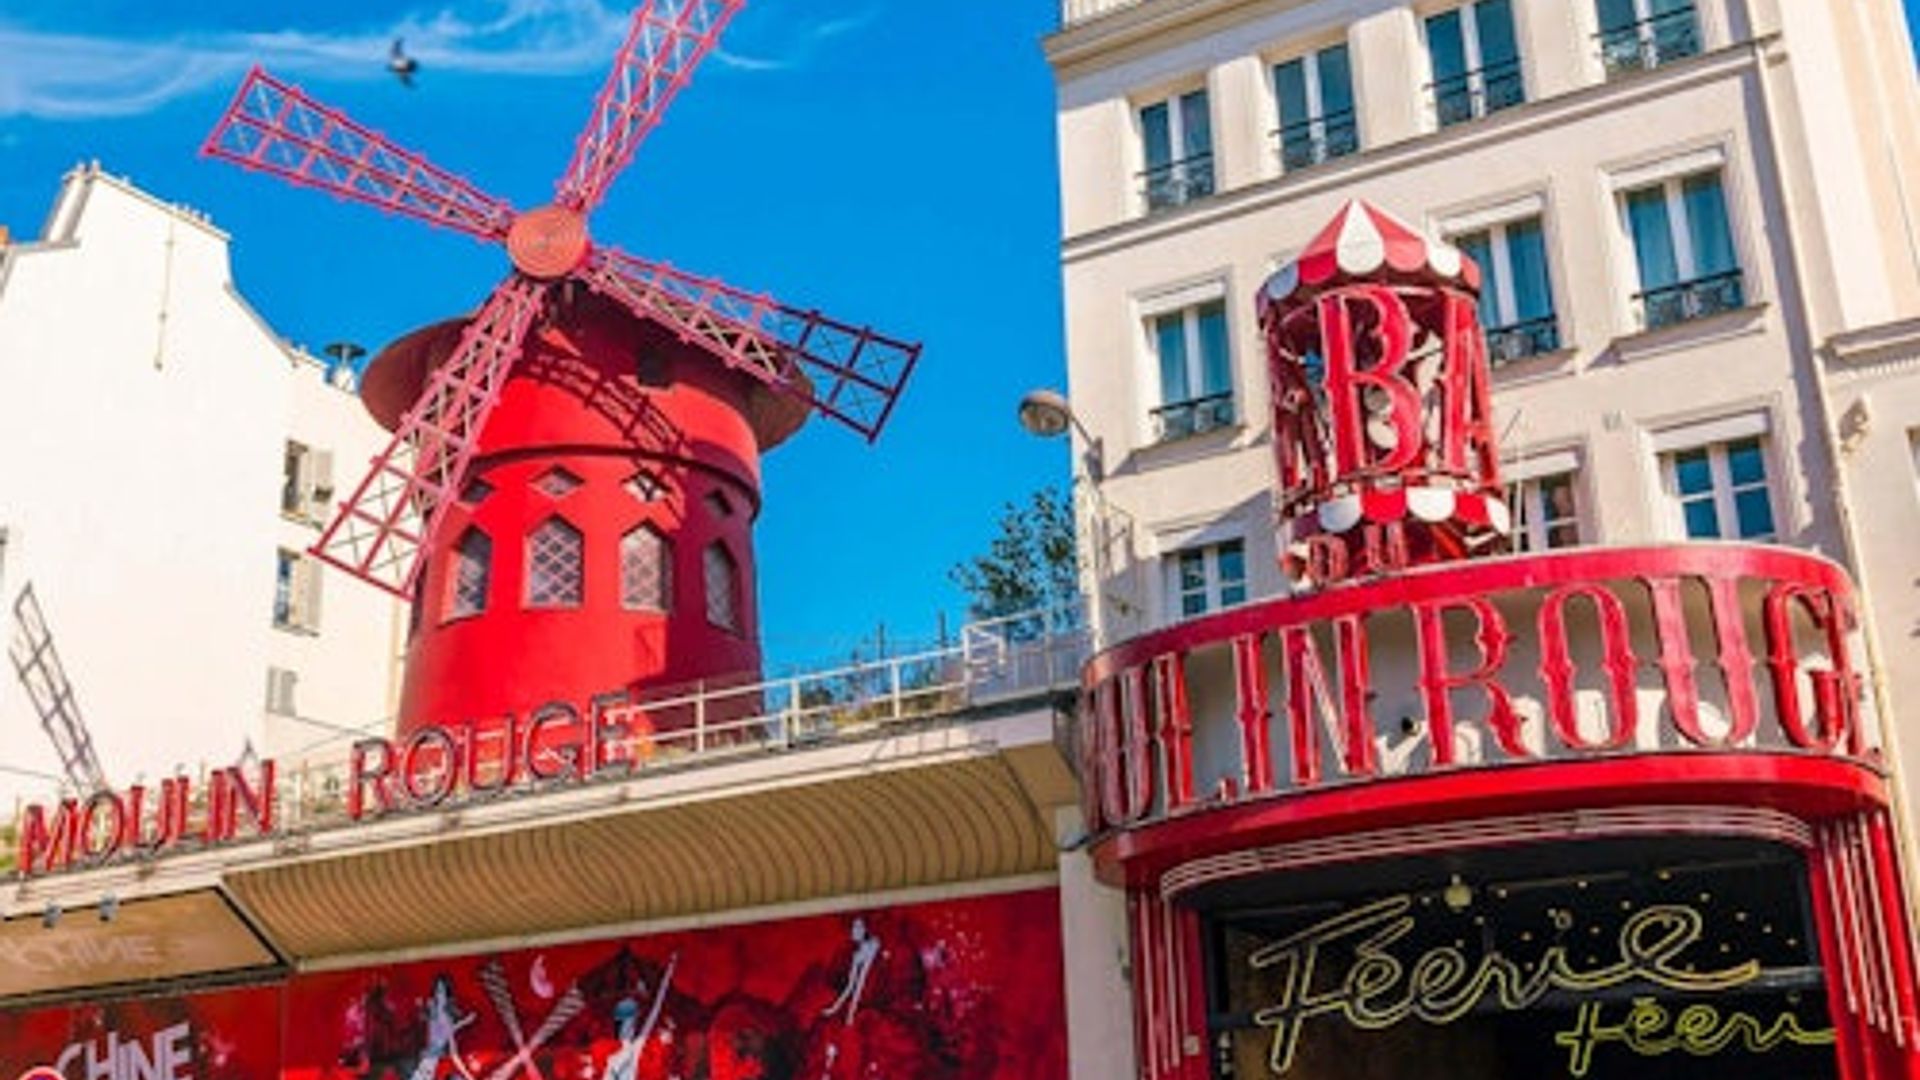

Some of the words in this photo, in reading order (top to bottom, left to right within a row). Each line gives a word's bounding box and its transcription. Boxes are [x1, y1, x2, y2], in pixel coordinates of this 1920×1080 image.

[1408, 576, 1868, 766] ROUG
[17, 759, 275, 870] MOULIN
[346, 689, 638, 821] ROUGE
